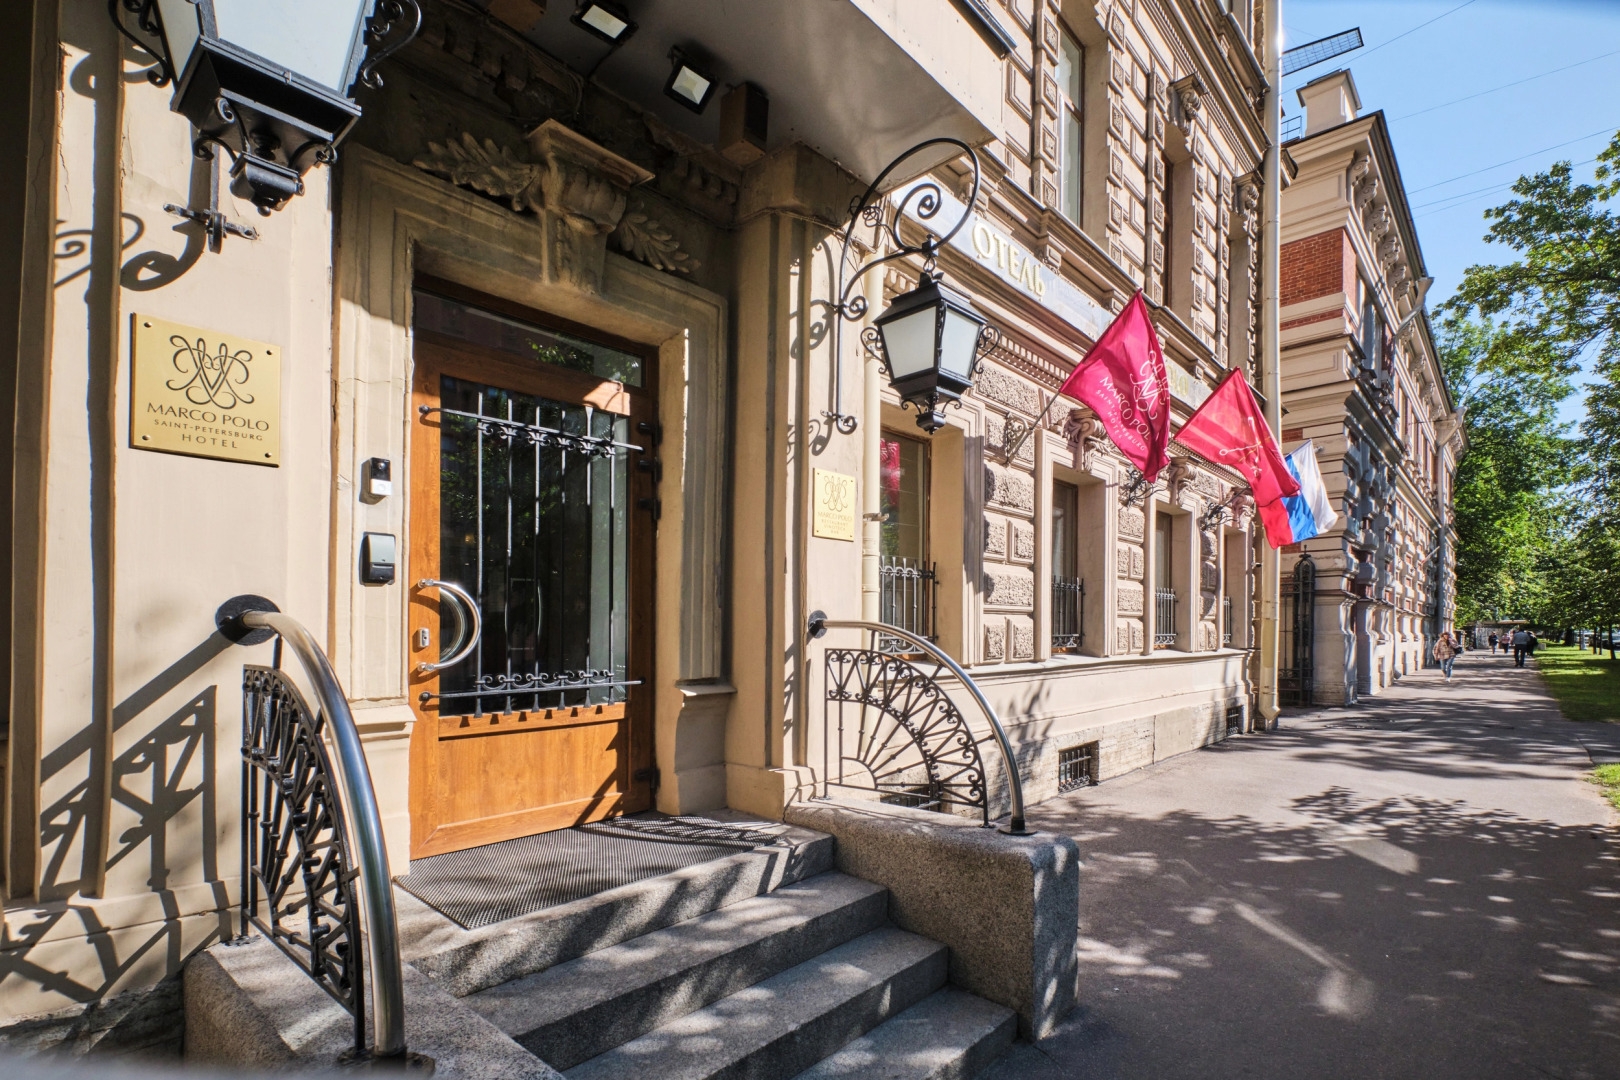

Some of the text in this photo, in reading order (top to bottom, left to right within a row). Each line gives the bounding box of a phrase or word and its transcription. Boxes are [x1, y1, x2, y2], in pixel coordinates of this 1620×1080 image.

[972, 221, 1046, 297] ОТЕЛЬ
[146, 402, 270, 432] MARCO POLO
[1099, 376, 1150, 441] MARCO POL
[154, 419, 263, 442] SAINT-PETERSBURG
[1107, 411, 1123, 439] HOTEL
[181, 433, 238, 449] HOTEL
[818, 511, 853, 522] MARCO POLO
